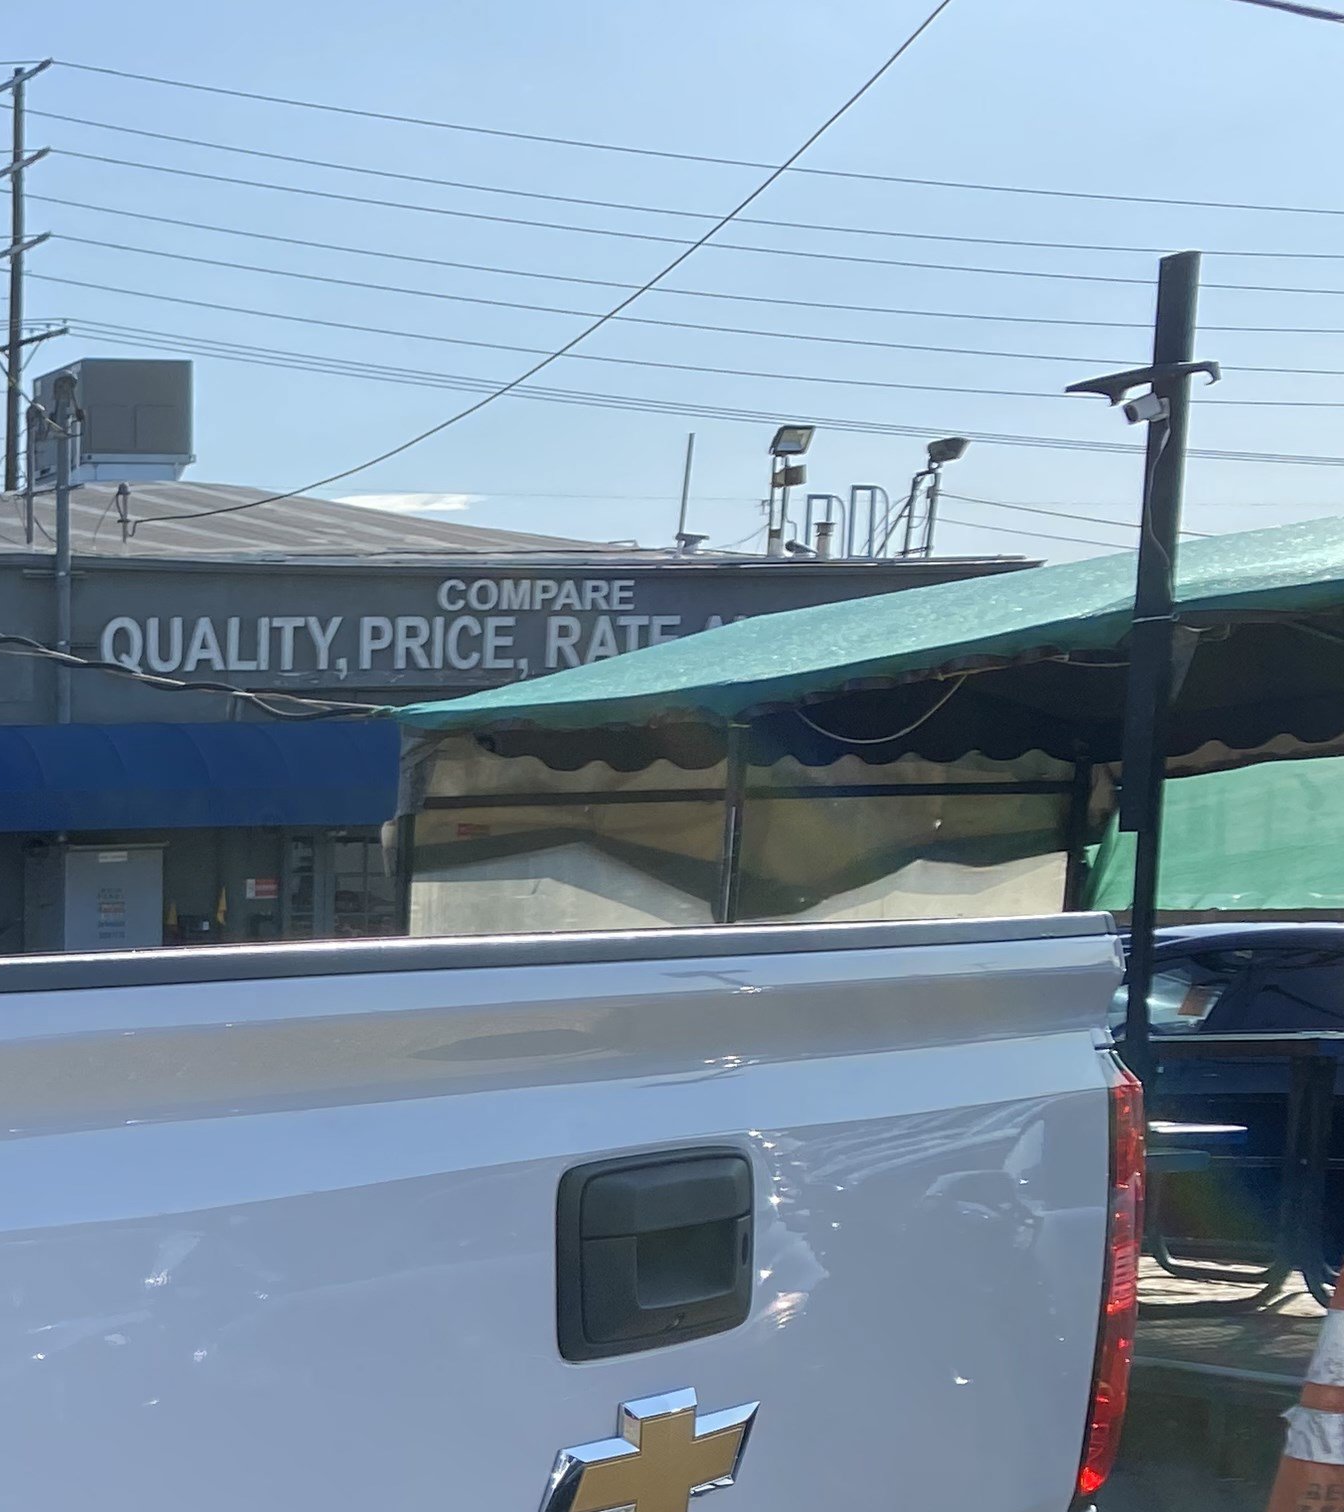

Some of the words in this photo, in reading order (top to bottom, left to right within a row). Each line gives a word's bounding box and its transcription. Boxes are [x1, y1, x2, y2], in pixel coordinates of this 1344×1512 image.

[437, 578, 636, 611] COMPARE
[100, 616, 348, 680] QUALITY,
[359, 614, 529, 680] PRICE,
